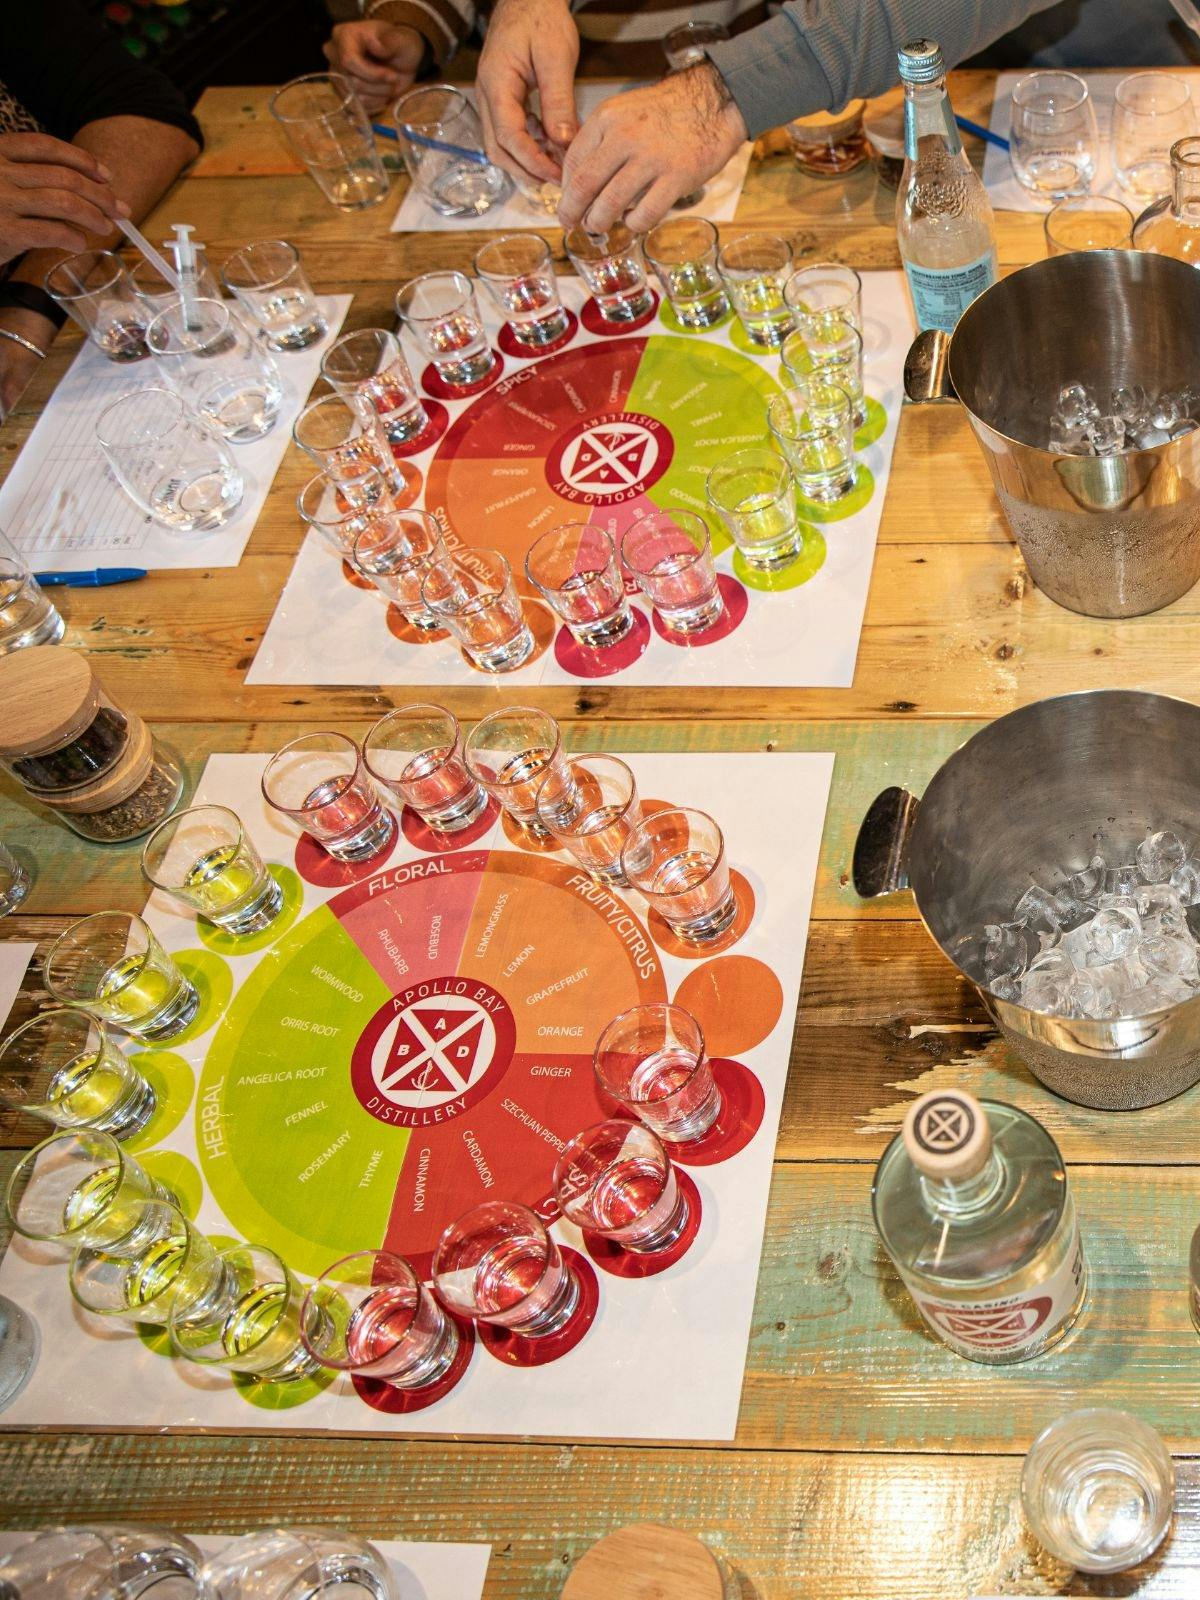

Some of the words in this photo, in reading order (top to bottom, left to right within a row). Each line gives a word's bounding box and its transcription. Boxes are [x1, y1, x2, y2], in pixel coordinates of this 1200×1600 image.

[495, 366, 539, 396] SPICY
[582, 413, 660, 431] DISTILLERY
[553, 481, 579, 499] BAY
[584, 482, 645, 505] APOLLO
[368, 859, 452, 896] FLORAL
[428, 915, 442, 960] ROSEBUD
[475, 893, 508, 958] LEMONGRASS
[565, 874, 657, 980] FRUITY/CITRUS
[378, 929, 410, 975] RHUBARB
[503, 944, 536, 978] LEMON
[311, 965, 363, 1003] WORMWOOD
[393, 981, 467, 1011] APOLLO
[474, 988, 505, 1014] BAY
[526, 967, 589, 1006] GRAPEFRUIT
[281, 1016, 309, 1032] ORRIS
[310, 1024, 340, 1038] ROOT
[434, 1017, 447, 1030] A
[537, 1026, 584, 1037] ORANGE
[397, 1044, 410, 1056] B
[456, 1046, 470, 1057] D
[237, 1071, 293, 1087] ANGELICA
[295, 1067, 327, 1080] ROOT
[530, 1066, 572, 1078] GINGER
[201, 1075, 228, 1160] HERBAL
[284, 1101, 328, 1127] FENNEL
[367, 1097, 467, 1126] DISTILLERY
[500, 1098, 542, 1136] SZECHUAN
[298, 1130, 352, 1184] ROSEMARY
[358, 1149, 383, 1189] THYME
[462, 1130, 495, 1189] CARDAMON
[413, 1148, 431, 1213] CINNAMON
